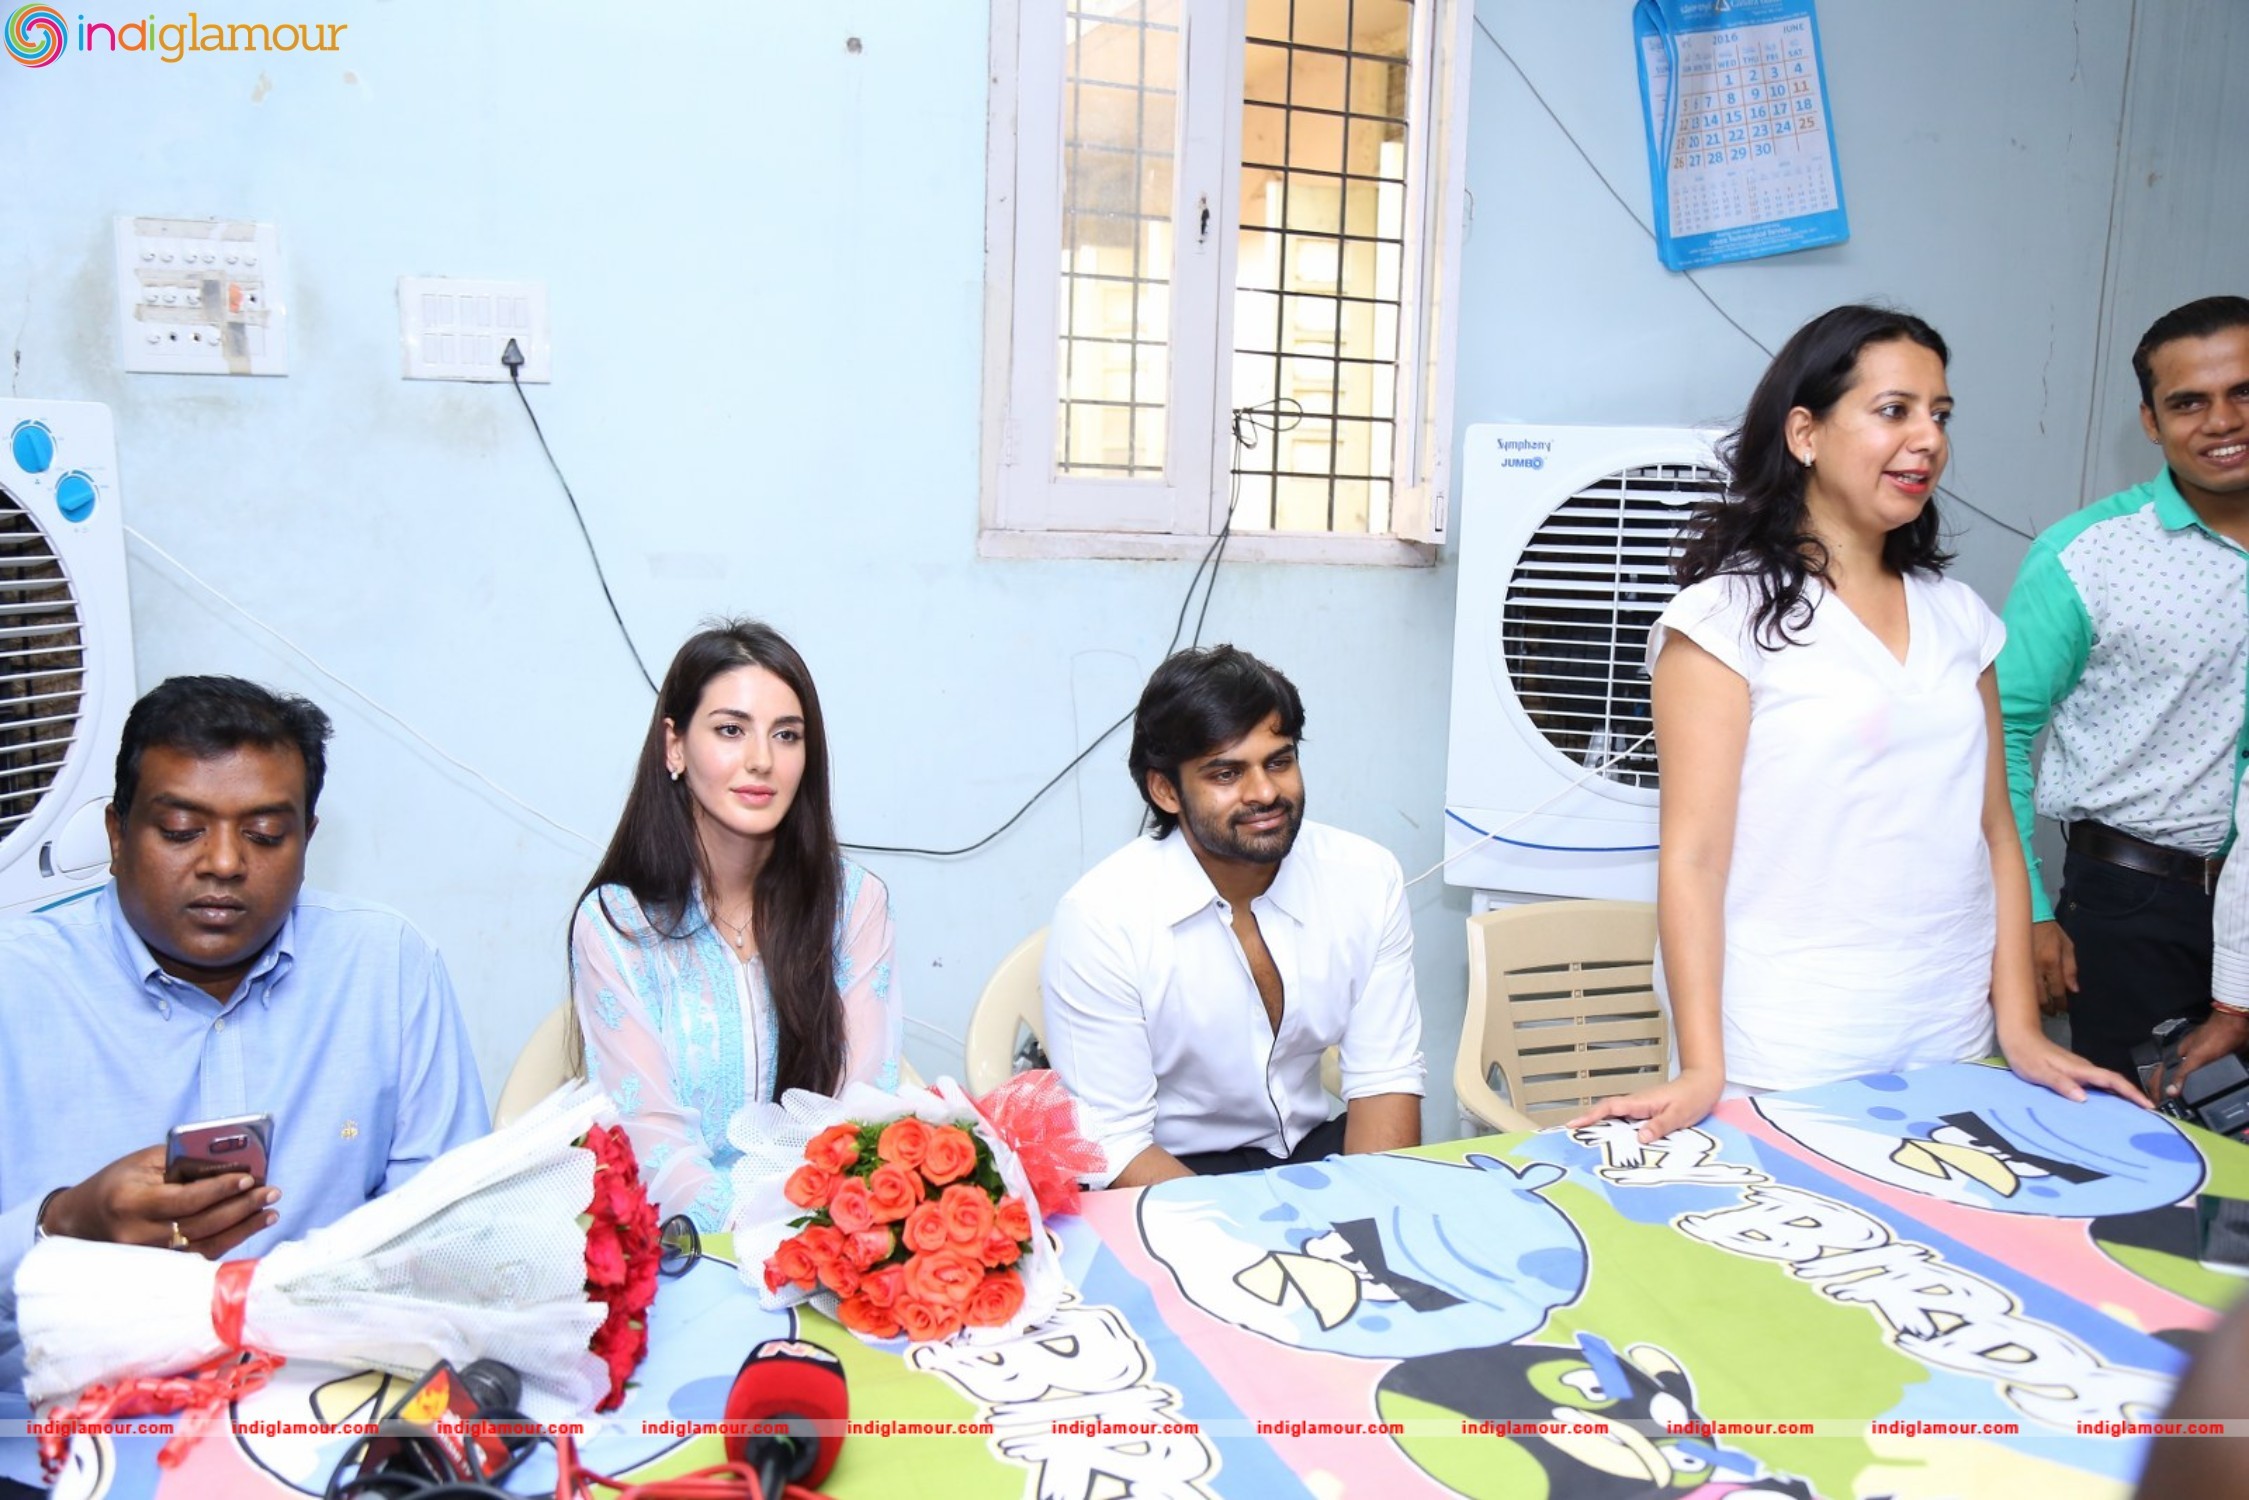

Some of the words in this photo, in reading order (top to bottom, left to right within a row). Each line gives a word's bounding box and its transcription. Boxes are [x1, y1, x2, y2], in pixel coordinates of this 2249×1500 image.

[1712, 33, 1739, 46] 2016
[1783, 23, 1805, 34] JUNE
[1716, 58, 1737, 69] WED
[1725, 74, 1734, 86] 1
[1749, 69, 1758, 82] 2
[1771, 67, 1780, 79] 3
[1794, 62, 1804, 75] 4
[1704, 96, 1713, 108] 7
[1726, 92, 1737, 105] 8
[1750, 87, 1761, 100] 9
[1770, 84, 1787, 98] 10
[1793, 80, 1810, 94] 11
[1703, 114, 1720, 127] 14
[1726, 110, 1743, 124] 15
[1750, 106, 1767, 119] 16
[1772, 103, 1788, 116] 17
[1796, 98, 1813, 112] 18
[1688, 135, 1700, 148] 20
[1705, 133, 1721, 146] 21
[1728, 129, 1745, 142] 22
[1752, 124, 1769, 137] 23
[1775, 120, 1792, 134] 24
[1799, 116, 1816, 129] 25
[1673, 156, 1686, 170] 26
[1689, 154, 1701, 167] 27
[1707, 151, 1724, 165] 28
[1730, 147, 1748, 161] 29
[1754, 143, 1772, 157] 30
[1496, 437, 1552, 453] Symphony
[1500, 456, 1544, 470] JUMBO
